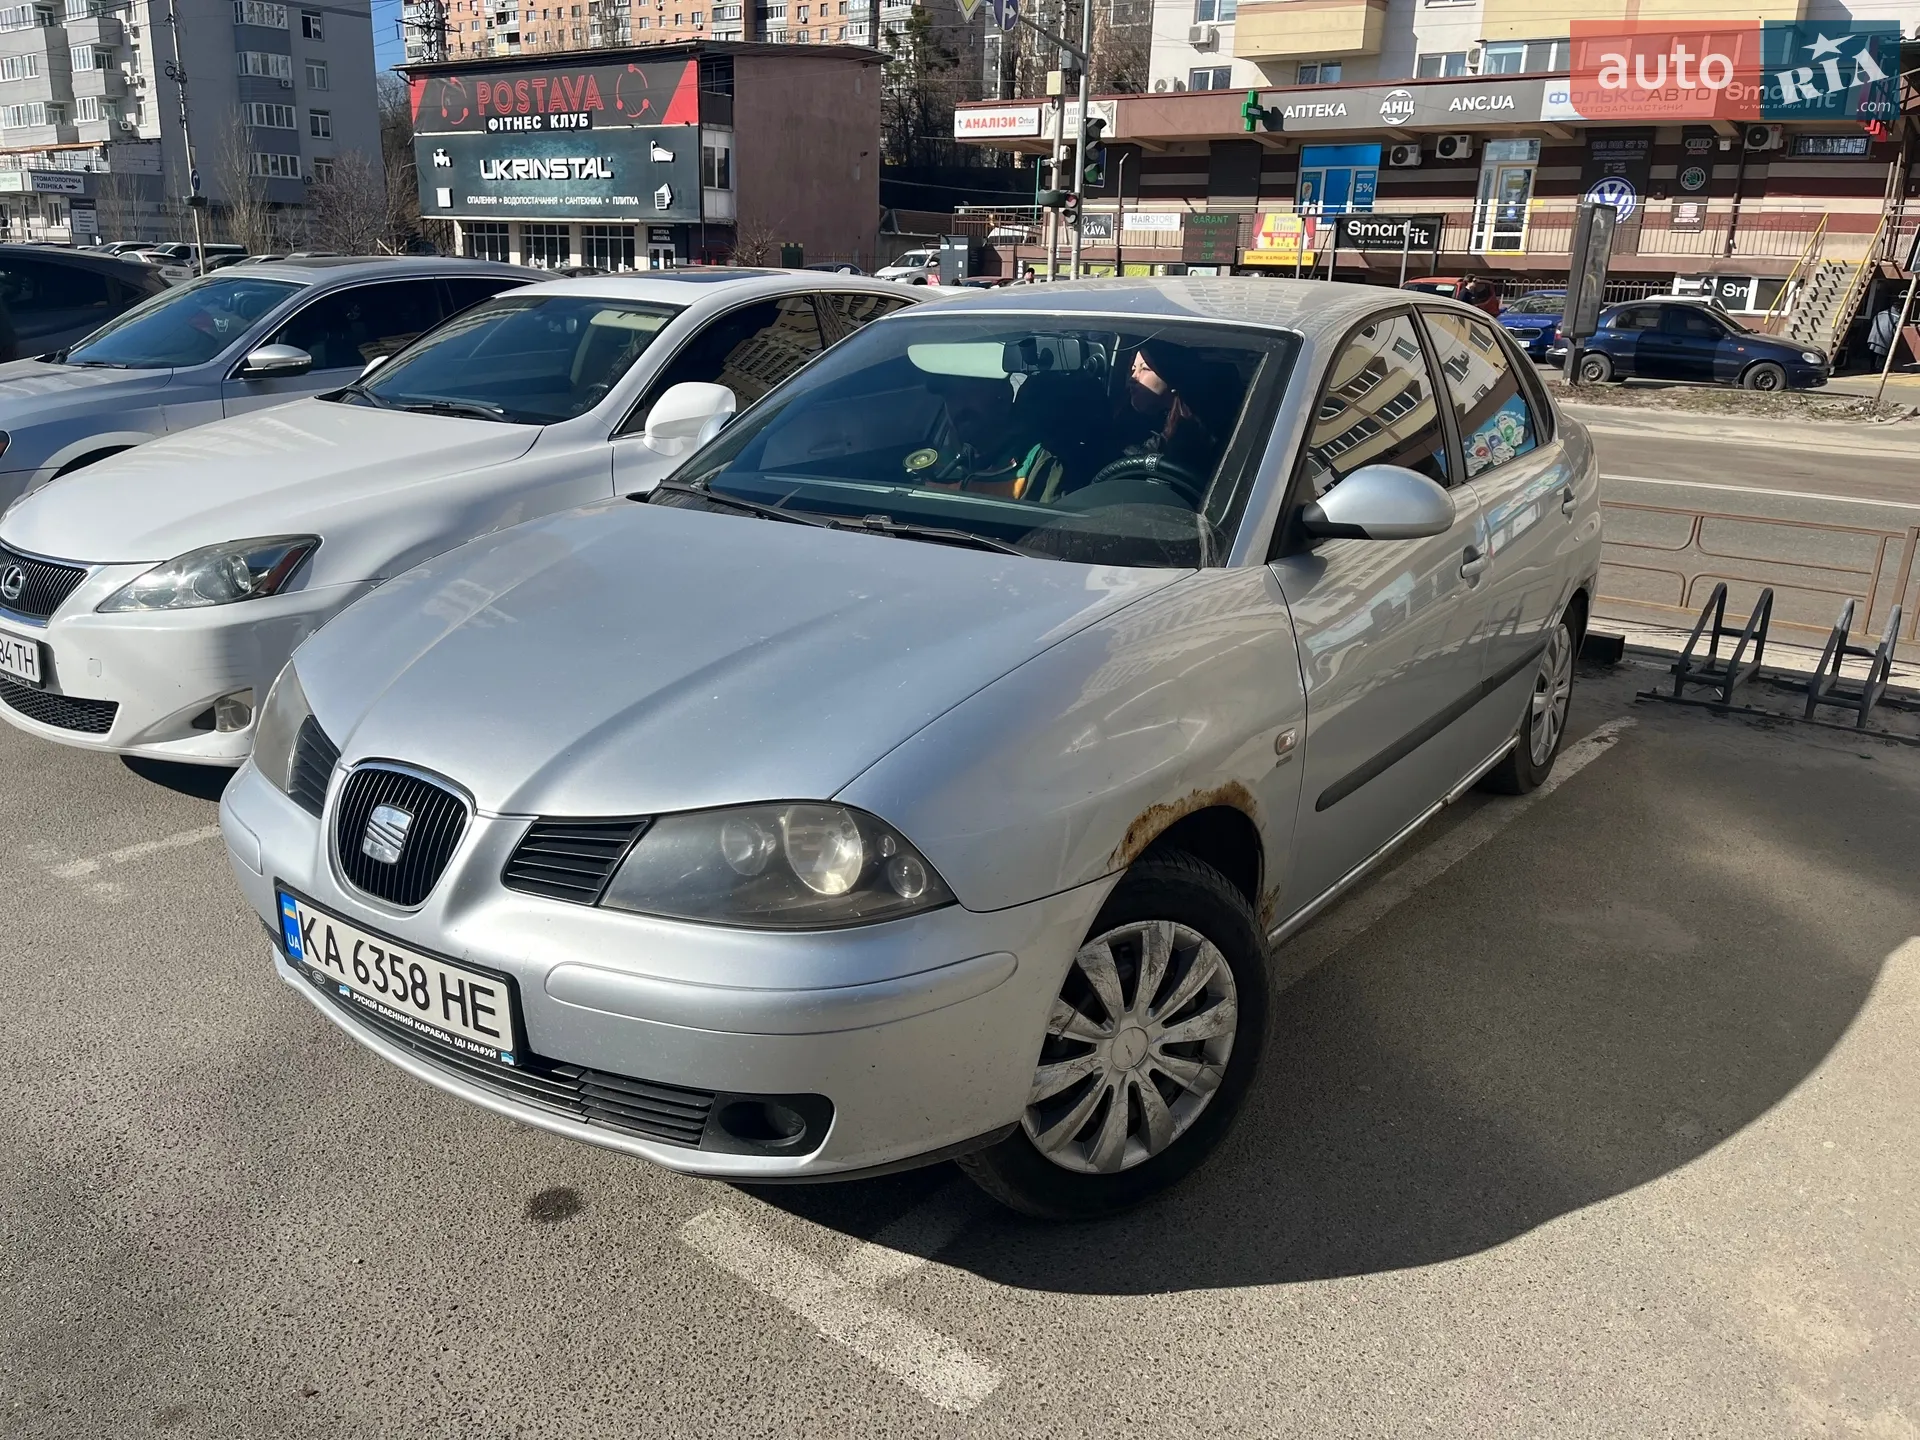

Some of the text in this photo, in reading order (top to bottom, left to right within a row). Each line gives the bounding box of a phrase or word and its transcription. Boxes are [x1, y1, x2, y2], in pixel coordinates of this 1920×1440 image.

[476, 74, 605, 116] POSTAVA
[1448, 95, 1515, 112] ANC.UA
[1549, 88, 1711, 106] ФОЛЬКСАВТО
[1283, 102, 1348, 119] АПТЕКА
[1379, 100, 1415, 115] АНЦ
[488, 113, 589, 132] ФІТНЕС КЛУБ
[964, 116, 1017, 130] АНАЛІЗИ
[479, 156, 613, 180] UKRINSTAL
[36, 182, 63, 190] КЛІНІКА
[1355, 182, 1373, 193] 5%
[467, 195, 640, 206] ОПАЛЕННЯ ВОДОПОСТАЧАННЯ САНТЕХНІКА ПЛИТКА
[1193, 215, 1229, 224] GARANT
[1083, 225, 1106, 236] KAVA
[14, 643, 35, 676] TH
[287, 932, 301, 951] UA
[298, 910, 501, 1039] KA 6358 HE
[353, 991, 378, 1011] РУСКІЙ
